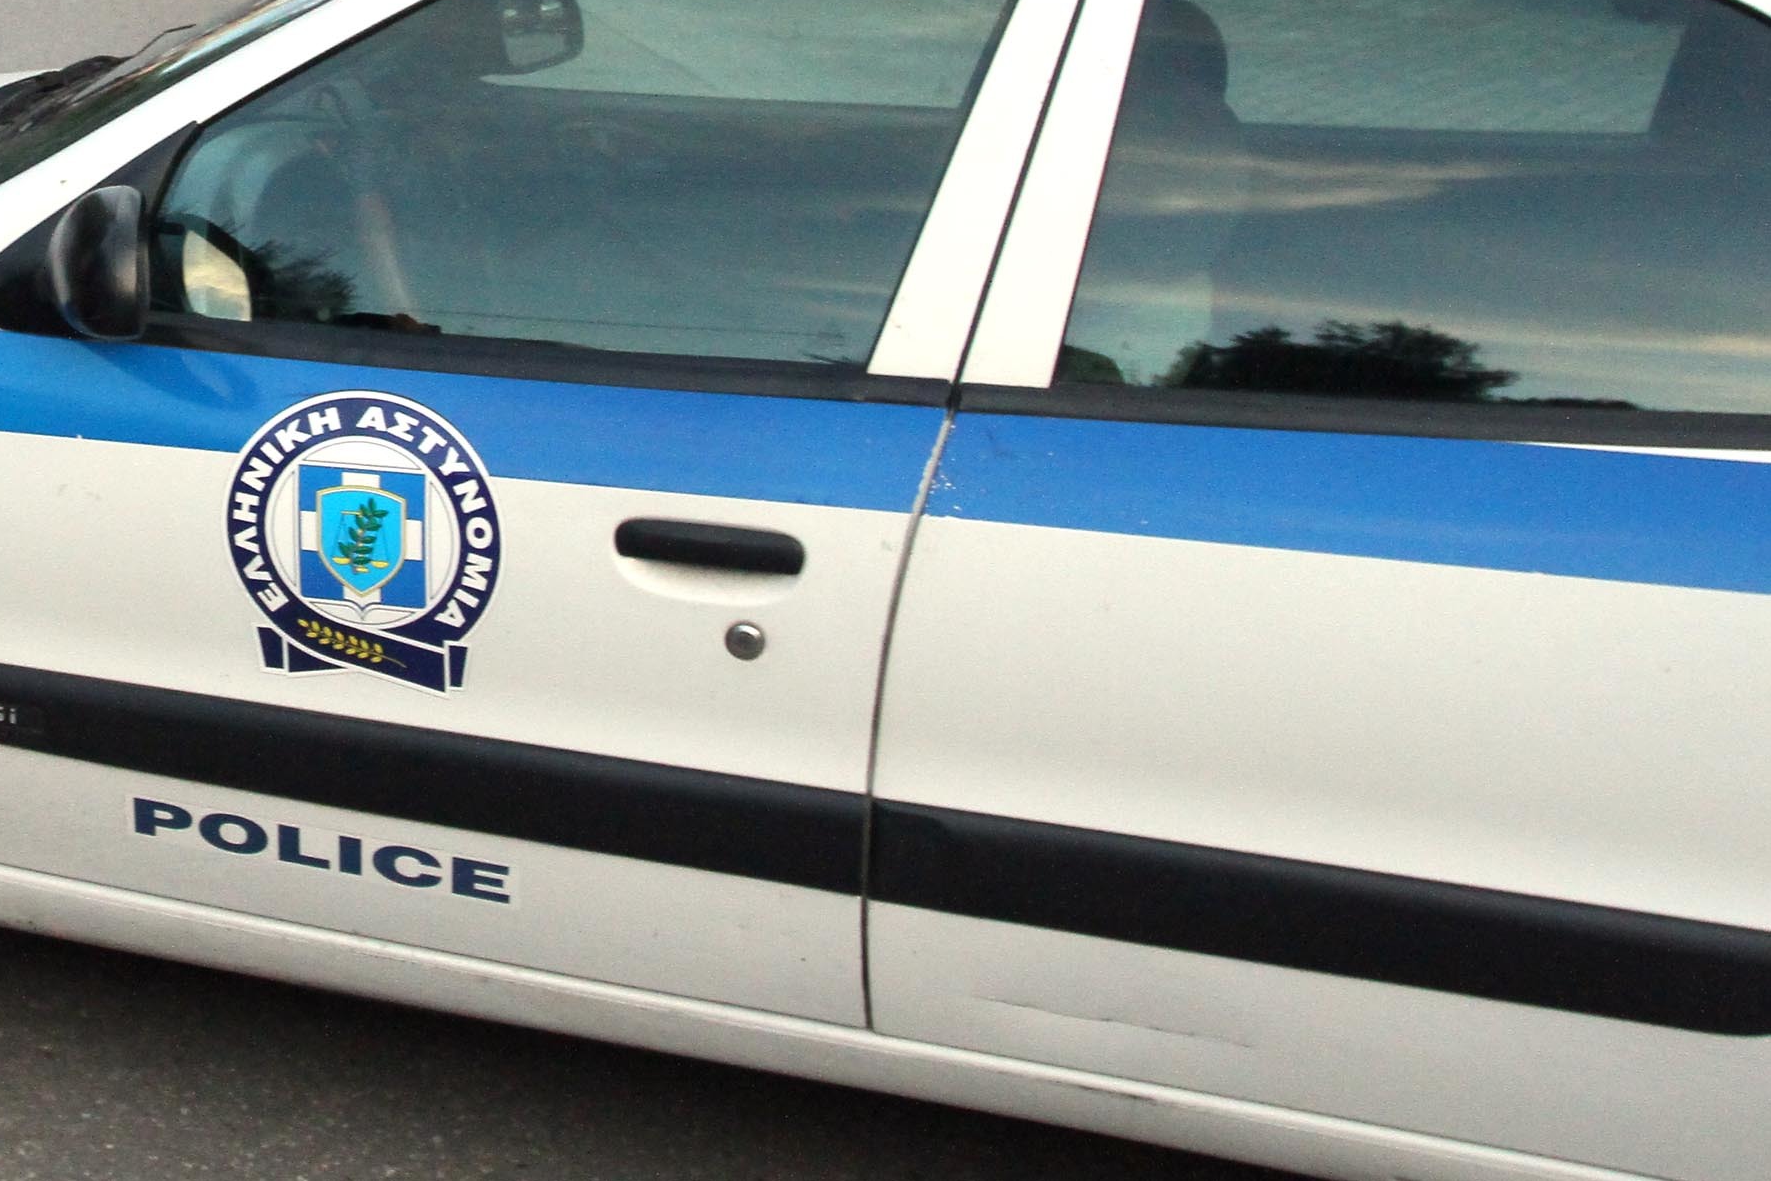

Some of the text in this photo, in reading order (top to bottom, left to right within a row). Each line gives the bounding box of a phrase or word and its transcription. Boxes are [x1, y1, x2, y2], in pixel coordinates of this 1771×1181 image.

[233, 406, 493, 628] ΕΛΛΗΝΙΚΗ ΑΣΤΥΝΟΜΙΑ
[133, 797, 510, 904] POLICE
